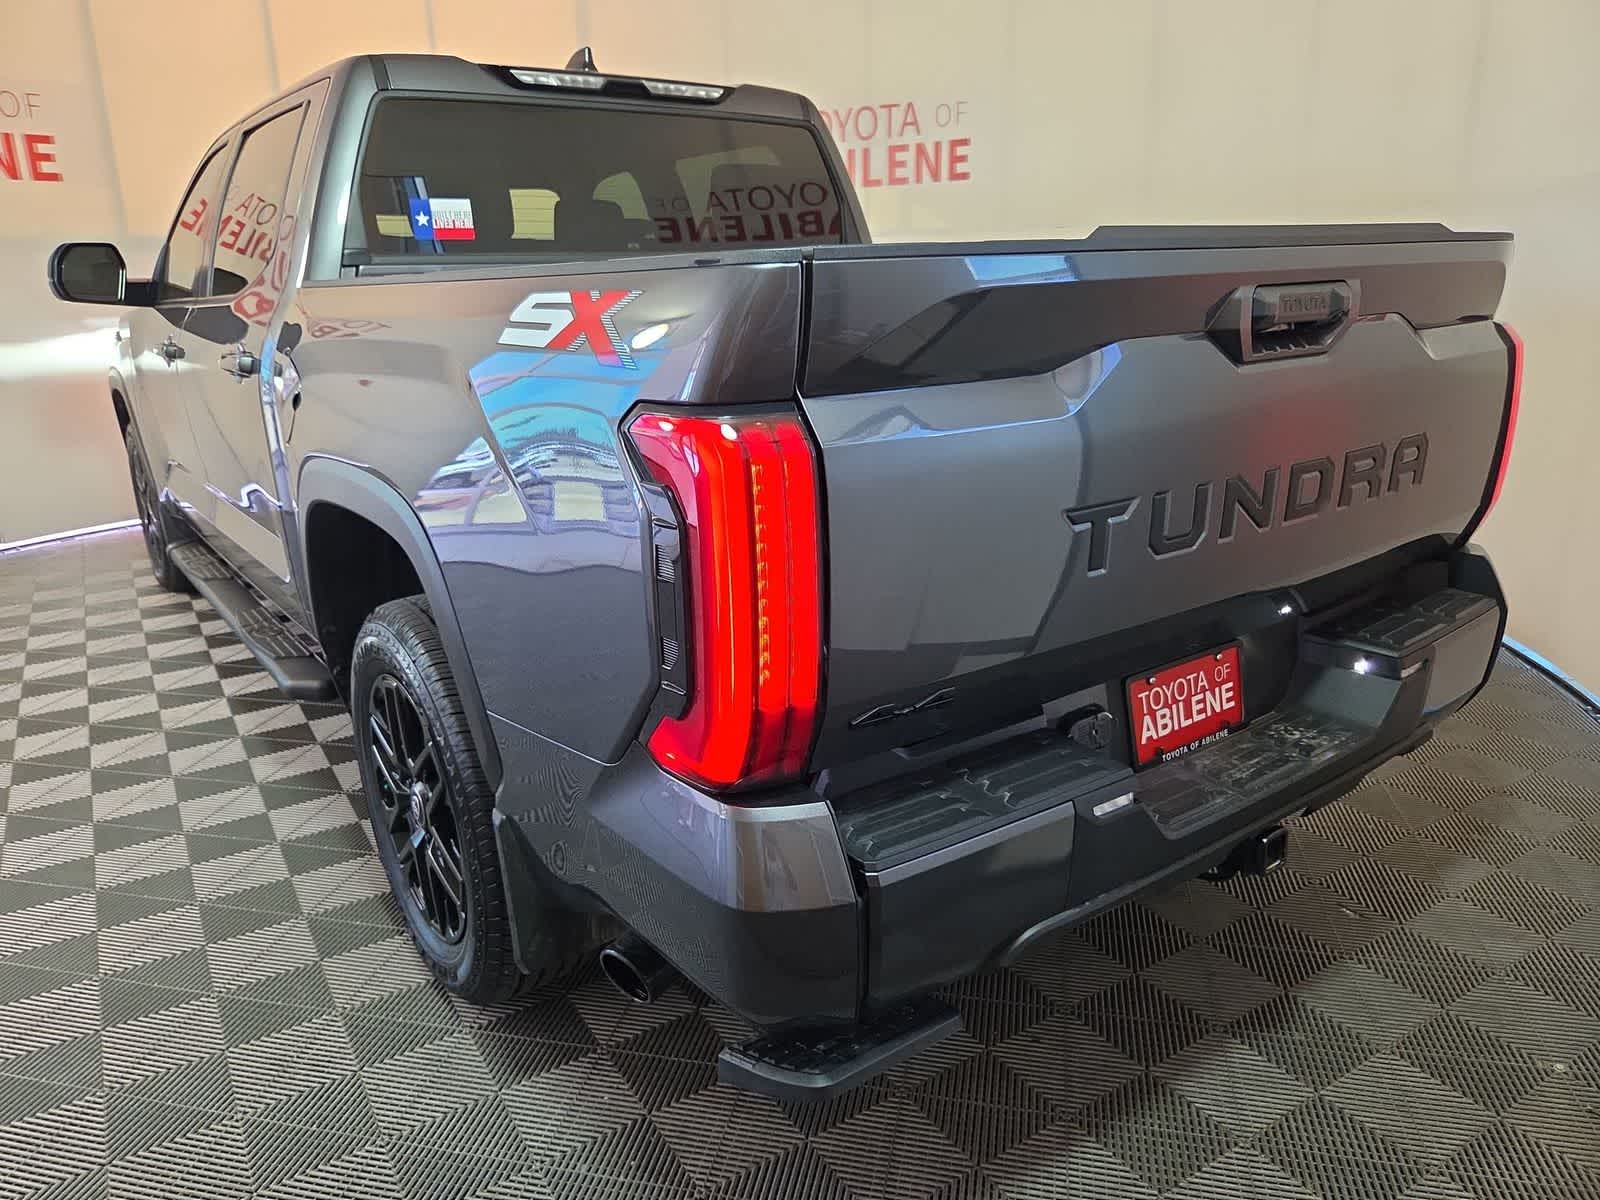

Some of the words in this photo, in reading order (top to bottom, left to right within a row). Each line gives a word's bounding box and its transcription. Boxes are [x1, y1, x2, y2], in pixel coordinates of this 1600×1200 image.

[936, 101, 968, 128] OF
[498, 289, 644, 370] SX
[1062, 431, 1429, 577] TUNDRA
[1138, 671, 1209, 714] TOYOTA
[1214, 663, 1231, 682] OF
[1141, 682, 1236, 745] ABILENE
[1162, 746, 1188, 762] TOYOTA
[1190, 741, 1199, 751] OF
[1201, 728, 1229, 746] ABILENE
